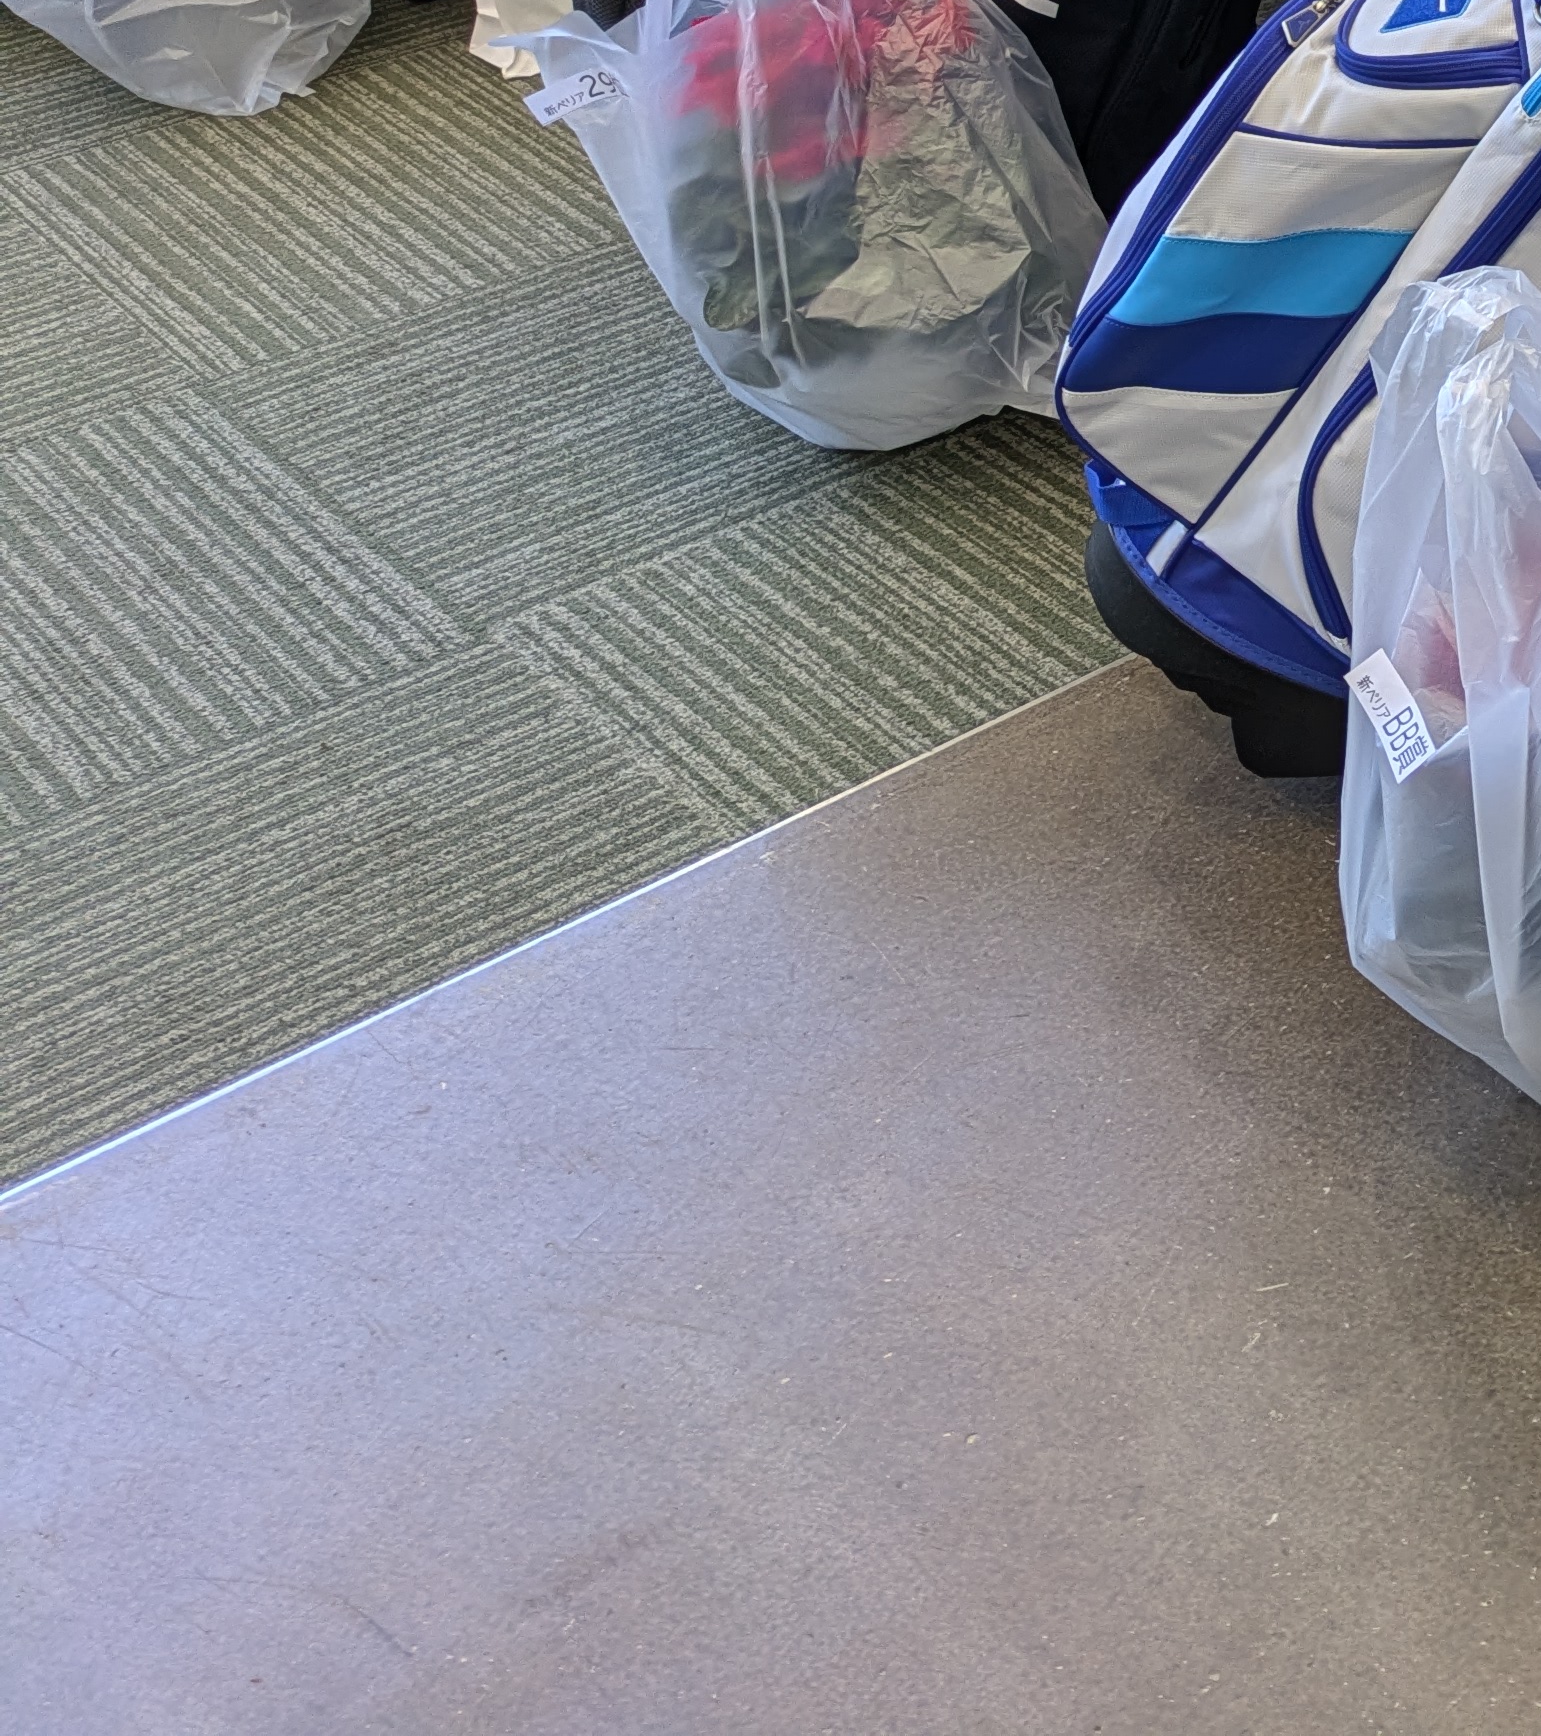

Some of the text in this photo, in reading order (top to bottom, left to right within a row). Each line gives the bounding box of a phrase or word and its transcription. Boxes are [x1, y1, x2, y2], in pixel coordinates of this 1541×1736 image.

[544, 90, 586, 117] 新ペリア
[1356, 673, 1430, 776] 新ペリア BB賞
